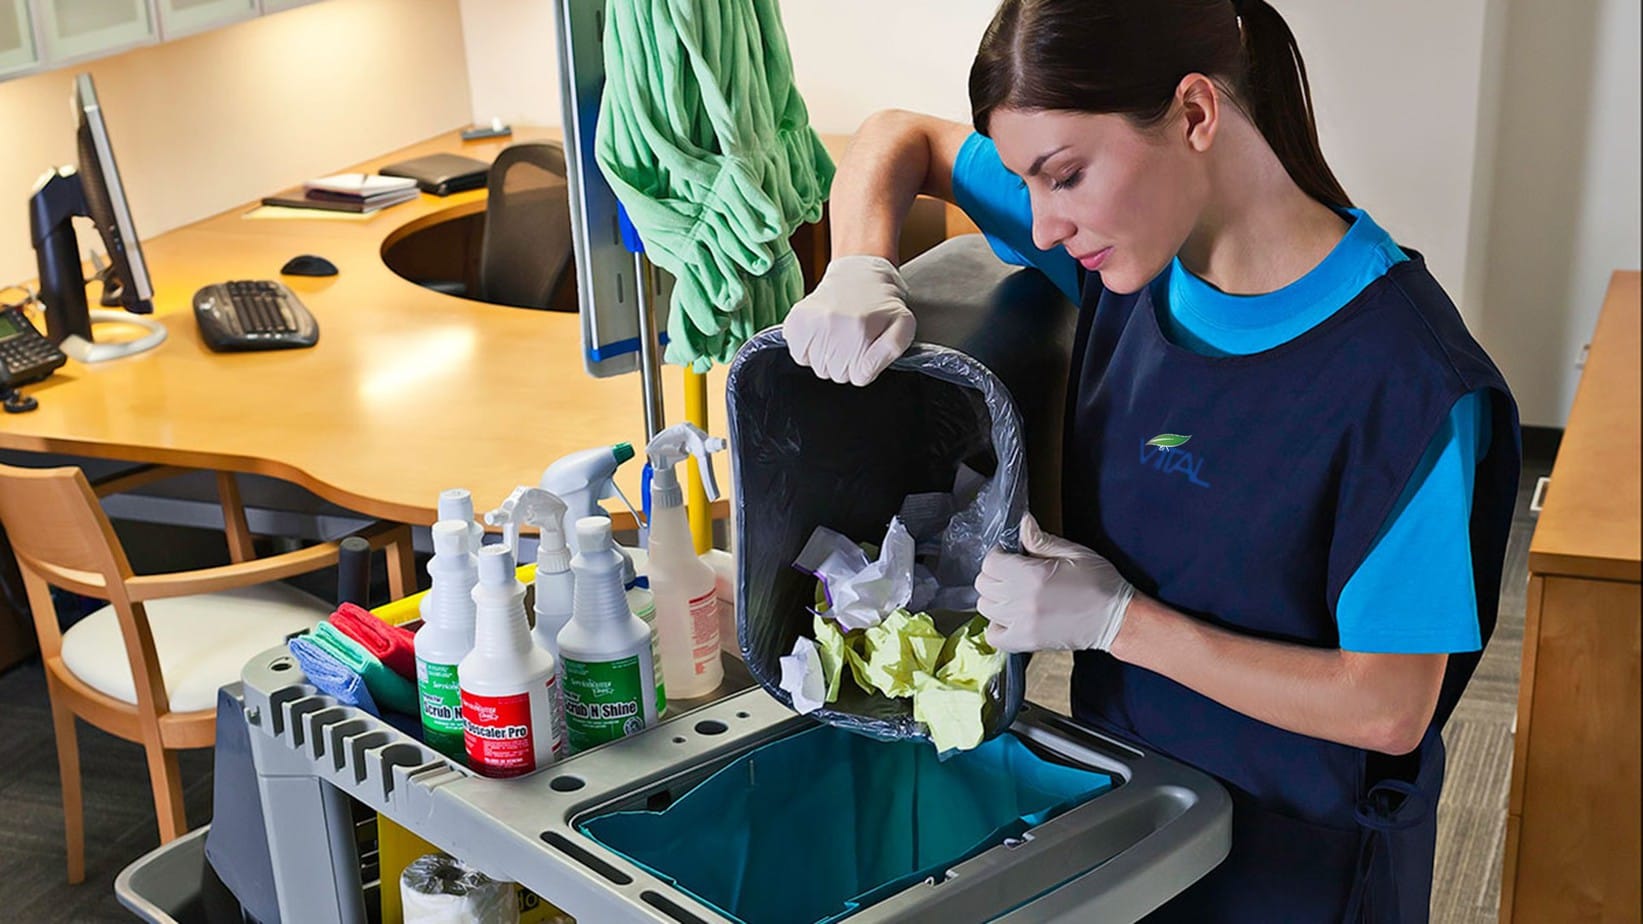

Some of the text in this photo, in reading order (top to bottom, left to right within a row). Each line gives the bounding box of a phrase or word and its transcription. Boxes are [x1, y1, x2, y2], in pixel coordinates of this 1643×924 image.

[424, 702, 452, 719] Scrub
[590, 703, 600, 717] N
[602, 702, 636, 717] Shine
[508, 727, 527, 739] Pro
